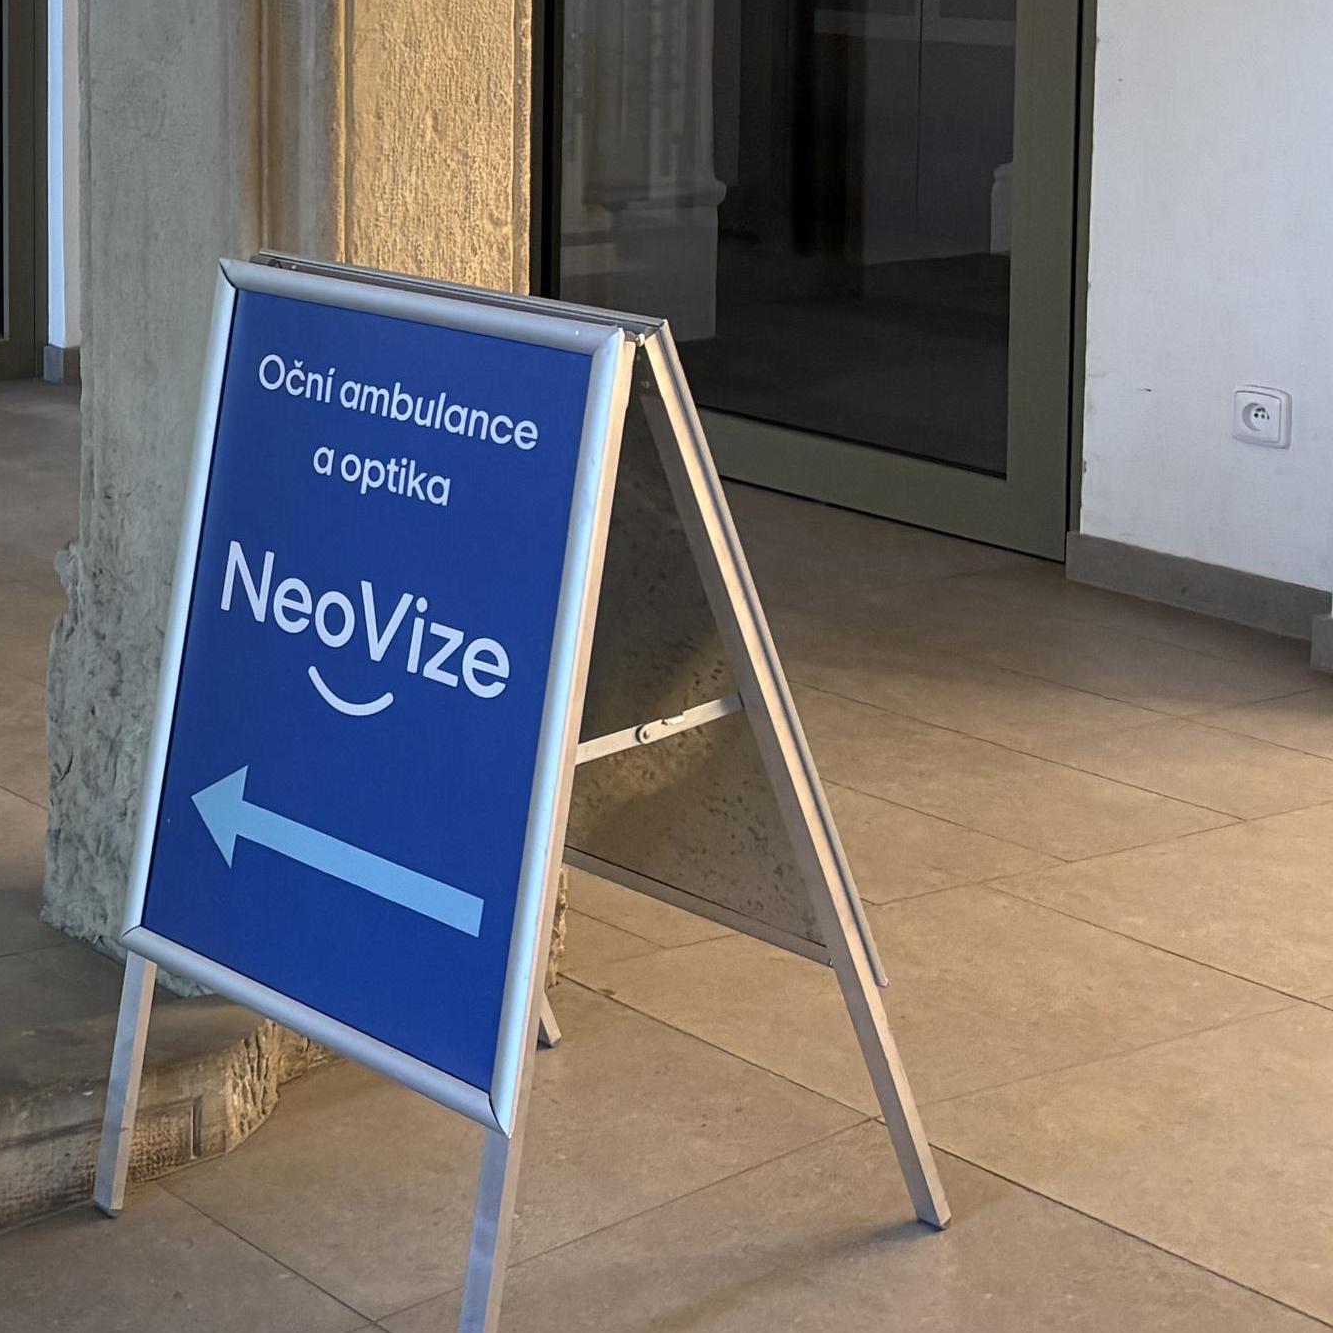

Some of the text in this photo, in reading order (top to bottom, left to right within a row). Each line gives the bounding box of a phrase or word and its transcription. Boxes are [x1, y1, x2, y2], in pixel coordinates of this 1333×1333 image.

[259, 354, 539, 451] Oční ambulance
[314, 446, 451, 507] a optika
[221, 541, 510, 699] NeoVize
